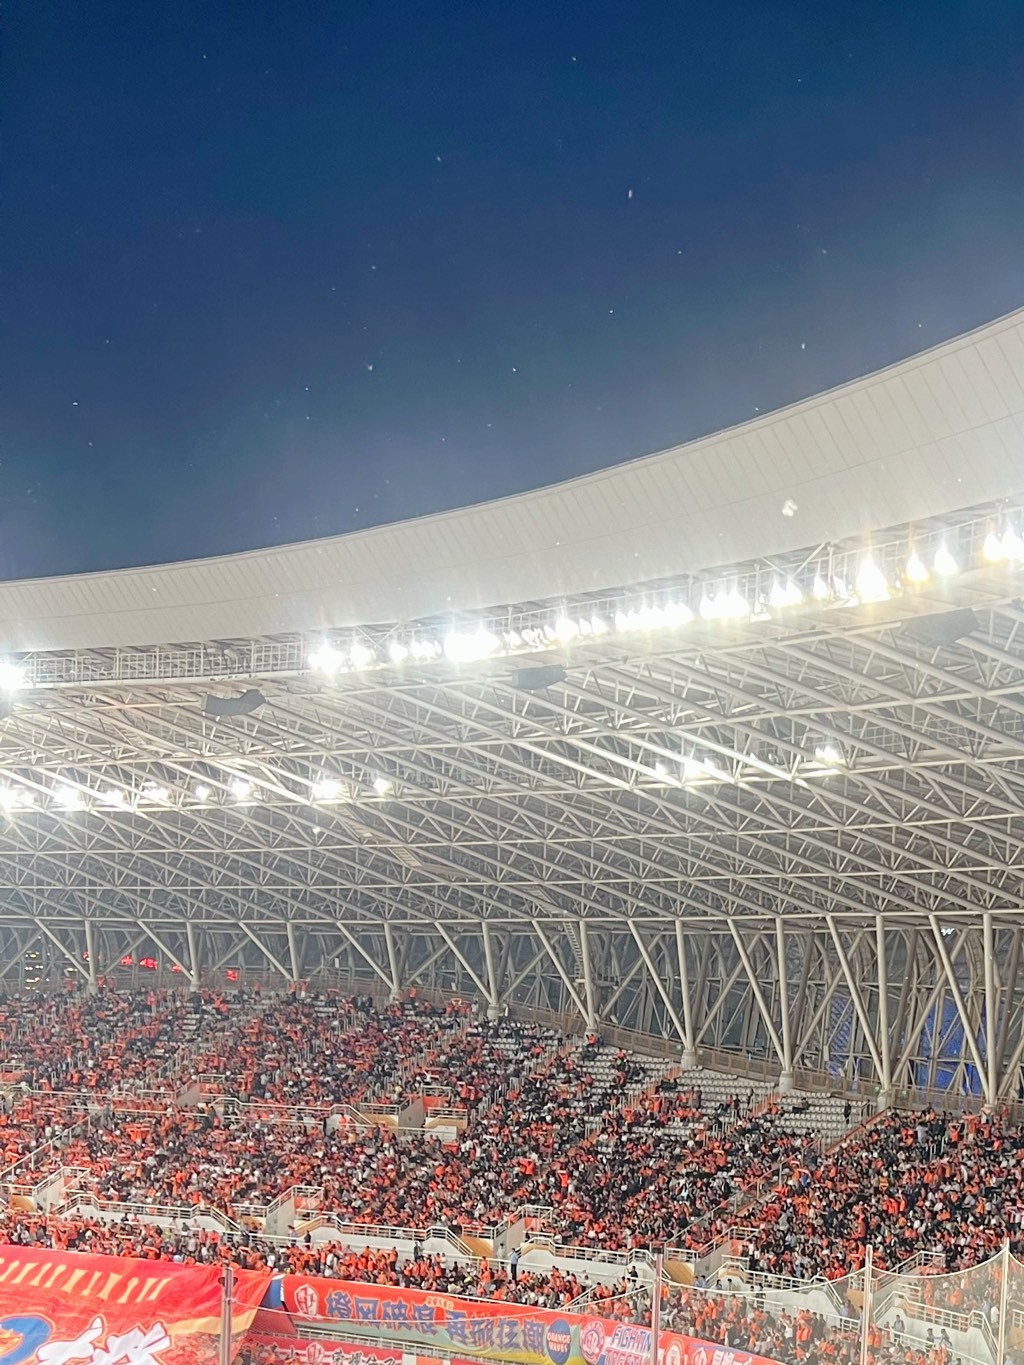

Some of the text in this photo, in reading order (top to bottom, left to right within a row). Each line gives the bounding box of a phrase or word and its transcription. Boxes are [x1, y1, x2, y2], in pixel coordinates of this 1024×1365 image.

[547, 1331, 572, 1344] ORANGE
[611, 1324, 661, 1355] FIGHTIN
[549, 1342, 569, 1353] WAVES
